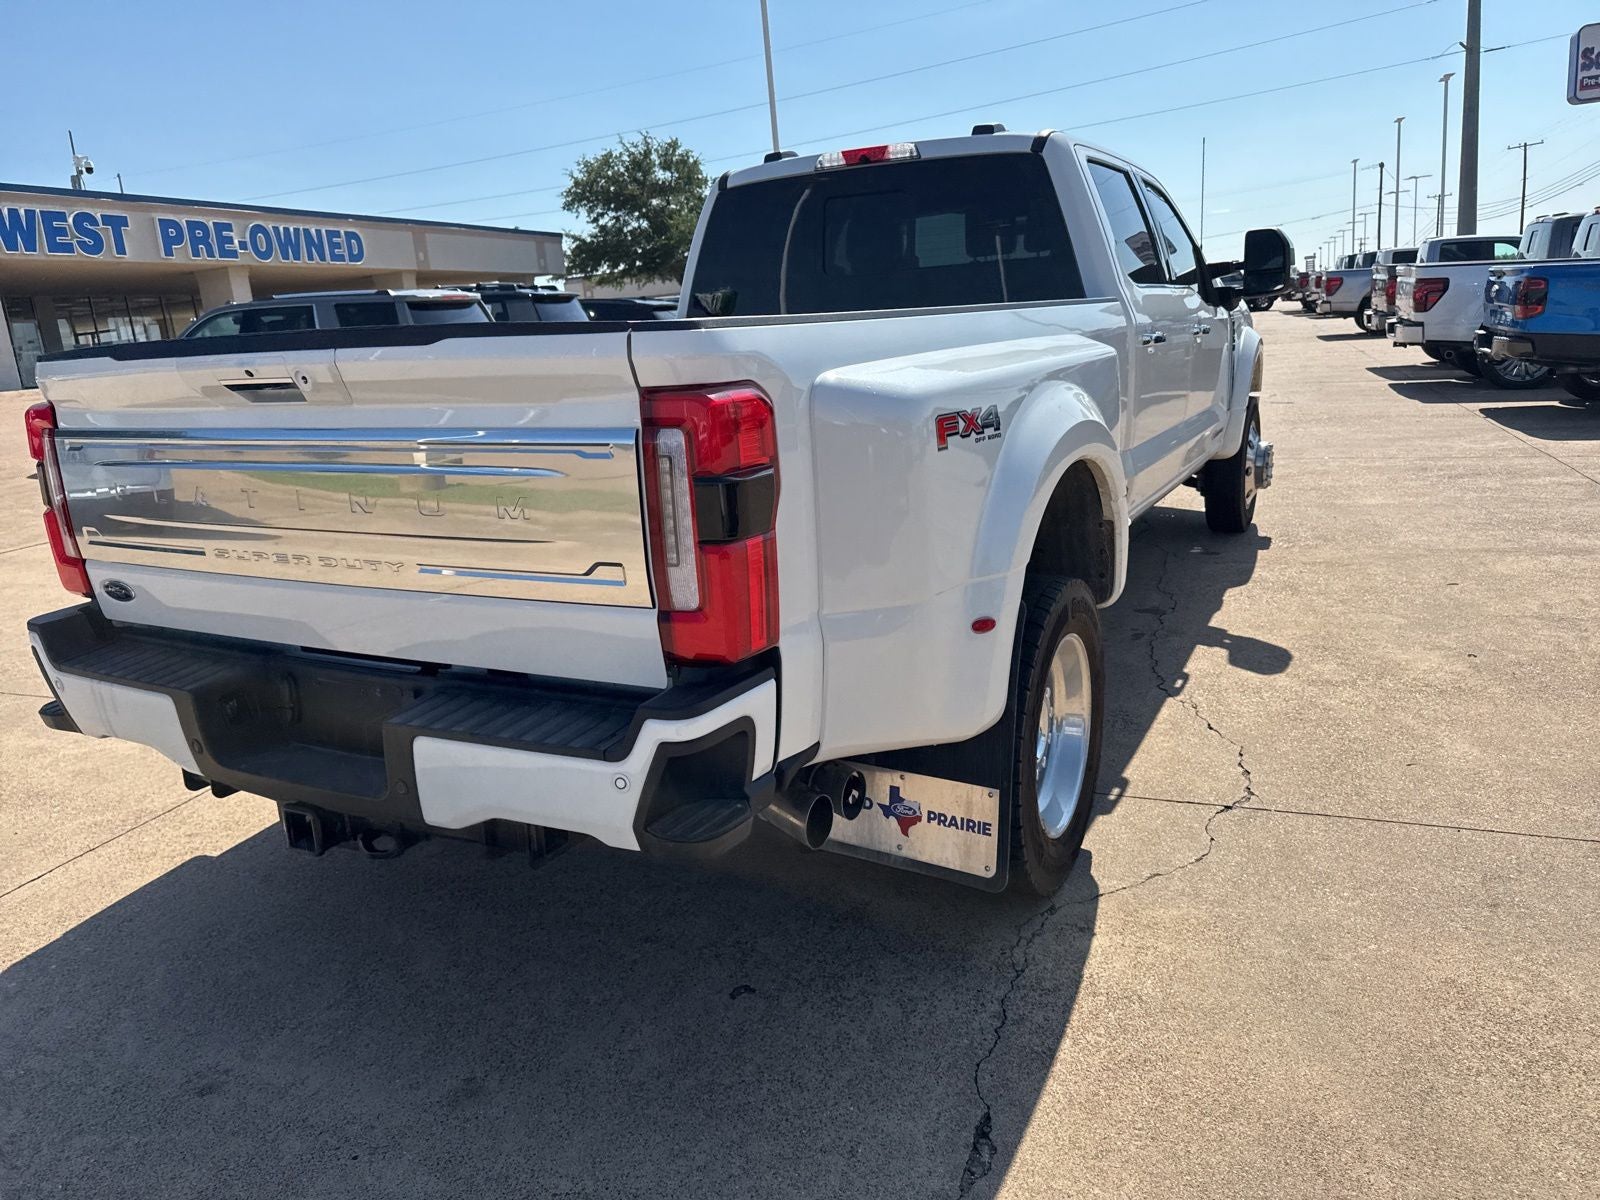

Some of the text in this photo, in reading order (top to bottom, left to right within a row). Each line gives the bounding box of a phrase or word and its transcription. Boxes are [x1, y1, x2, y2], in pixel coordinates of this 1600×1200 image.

[1583, 77, 1600, 86] Pre-
[0, 207, 365, 264] WEST PRE-OWNED
[935, 404, 1001, 452] FX4
[213, 547, 405, 573] SUPER DUTY
[894, 803, 915, 815] Ford
[927, 810, 992, 837] PRAIRIE
